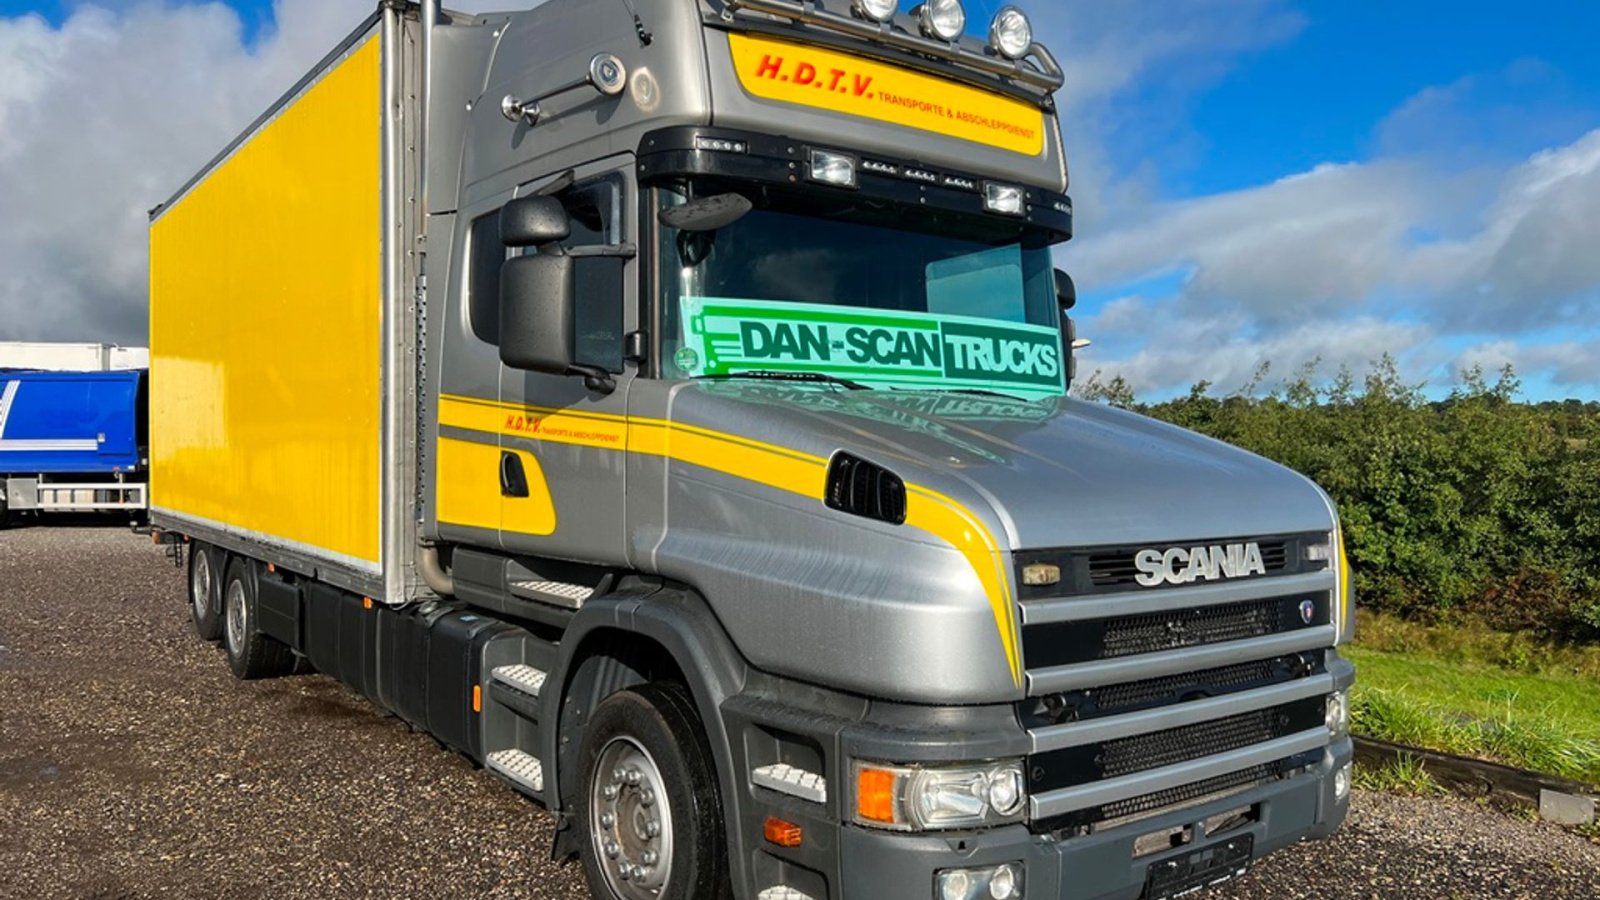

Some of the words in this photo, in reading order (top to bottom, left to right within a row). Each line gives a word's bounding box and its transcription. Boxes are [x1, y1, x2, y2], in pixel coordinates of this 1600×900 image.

[756, 54, 875, 99] H.D.T.V.
[878, 92, 944, 117] TRANSPORTE
[946, 108, 954, 118] &
[956, 111, 1034, 139] ABSCHLEPPDIENST
[740, 321, 942, 367] DAN-SCAN
[945, 334, 1058, 378] TRUCKS
[1135, 542, 1266, 587] SCANIA
